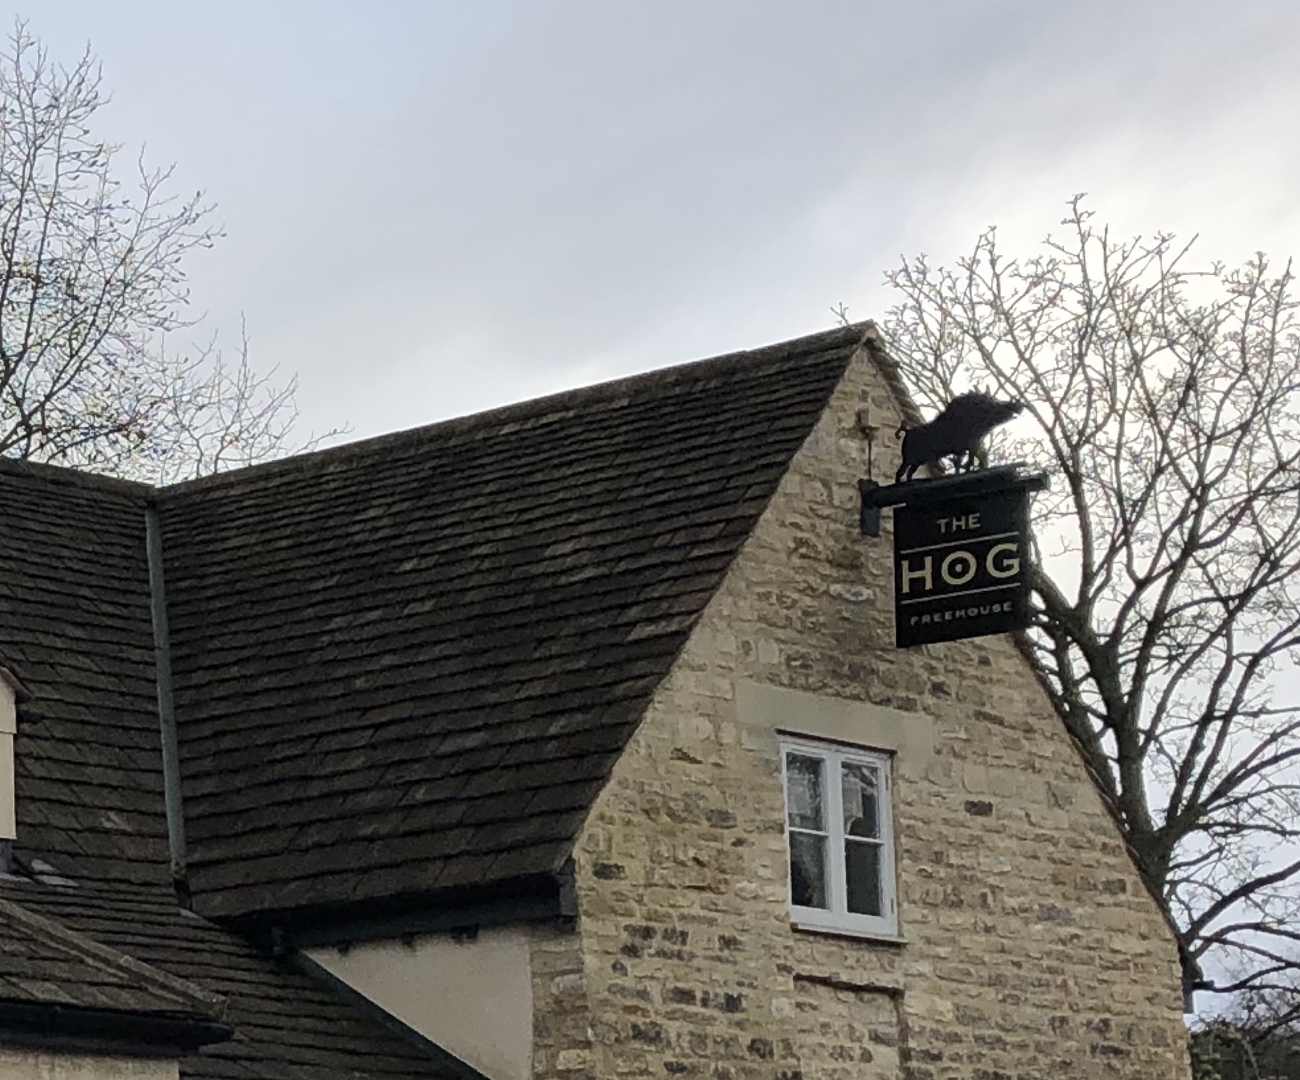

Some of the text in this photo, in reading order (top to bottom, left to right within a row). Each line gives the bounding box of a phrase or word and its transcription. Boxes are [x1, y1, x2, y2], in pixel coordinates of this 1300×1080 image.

[936, 512, 981, 534] THE
[900, 542, 1021, 594] HOG
[909, 600, 1013, 627] FREEHOUSE
